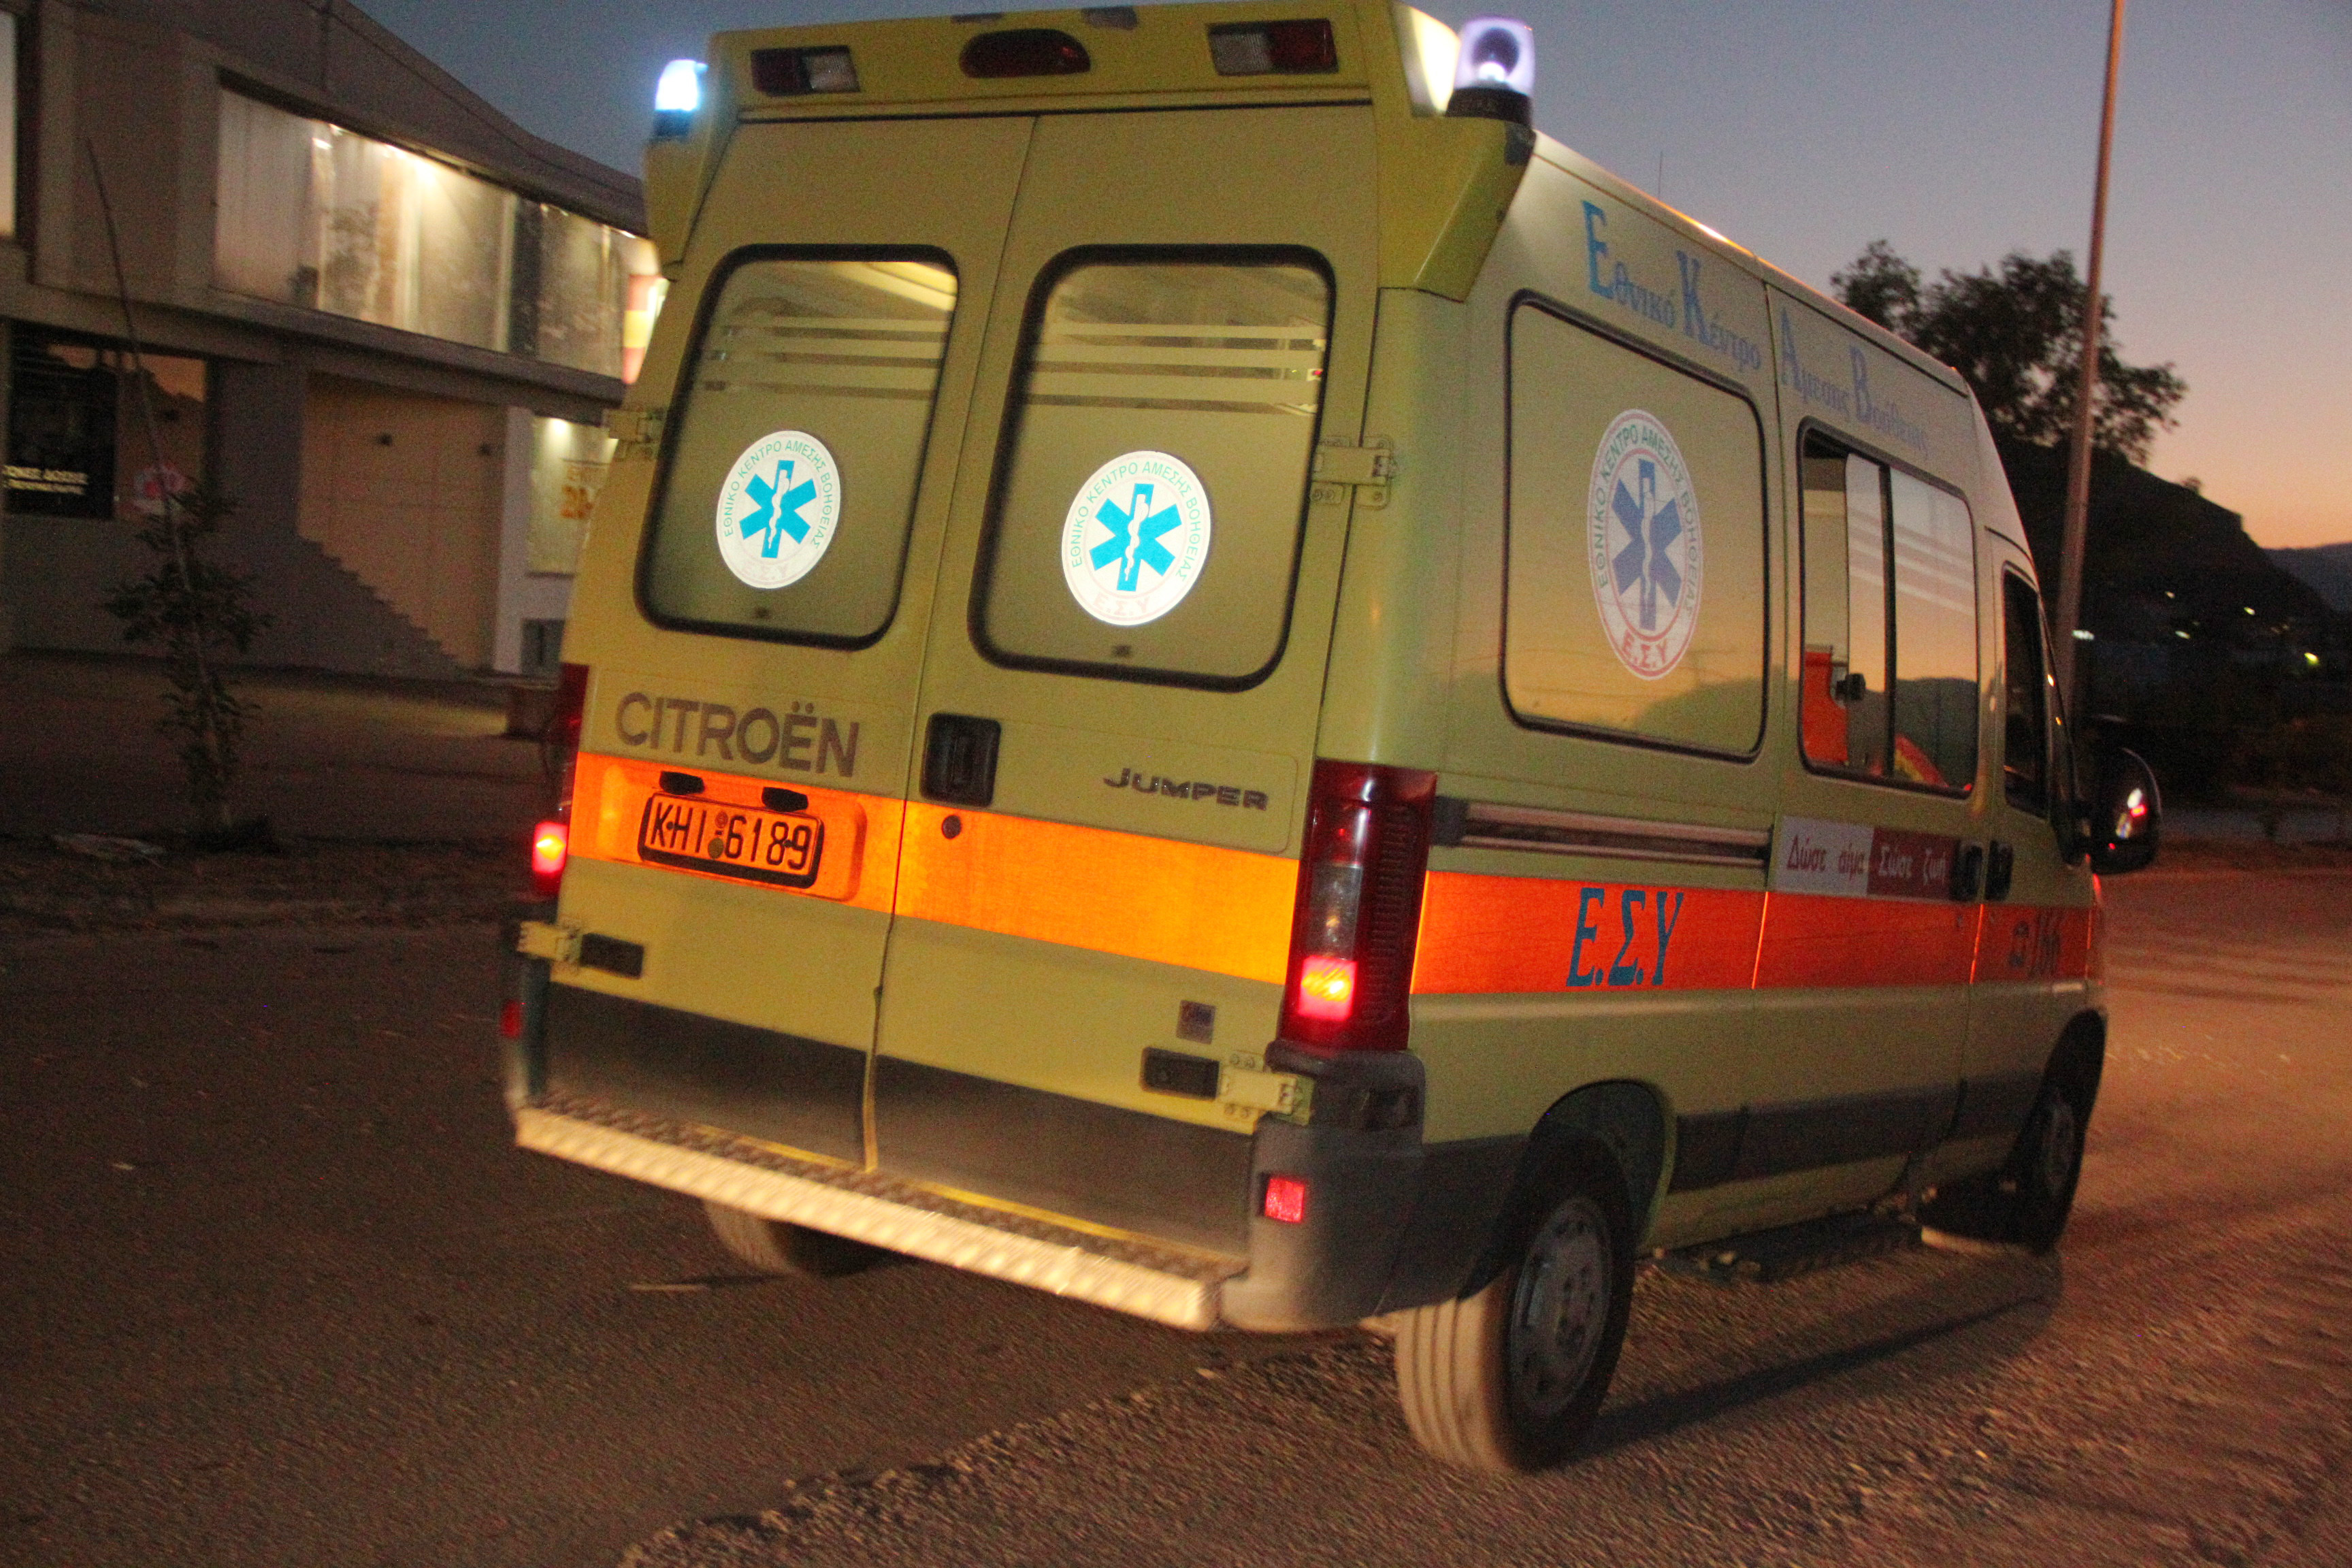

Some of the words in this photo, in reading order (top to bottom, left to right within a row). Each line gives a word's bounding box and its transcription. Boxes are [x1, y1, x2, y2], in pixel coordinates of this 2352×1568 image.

[723, 480, 740, 537] ΕΘΝΙΚΟ
[738, 440, 782, 478] ΚΕΝΤΡΟ
[785, 440, 826, 473] ΑΜΕΣΗΣ
[811, 472, 834, 549] ΒΟΗΘΕΙΑΣ
[1070, 506, 1089, 568] ΕΘΝΙΚΟ
[1086, 462, 1139, 504] ΚΕΝΤΡΟ
[1141, 461, 1192, 497] ΑΜΕΣΗΣ
[1175, 497, 1202, 582] ΒΟΗΘΕΙΑΣ
[615, 692, 860, 778] CITROËN
[1102, 767, 1269, 811] JUMPER
